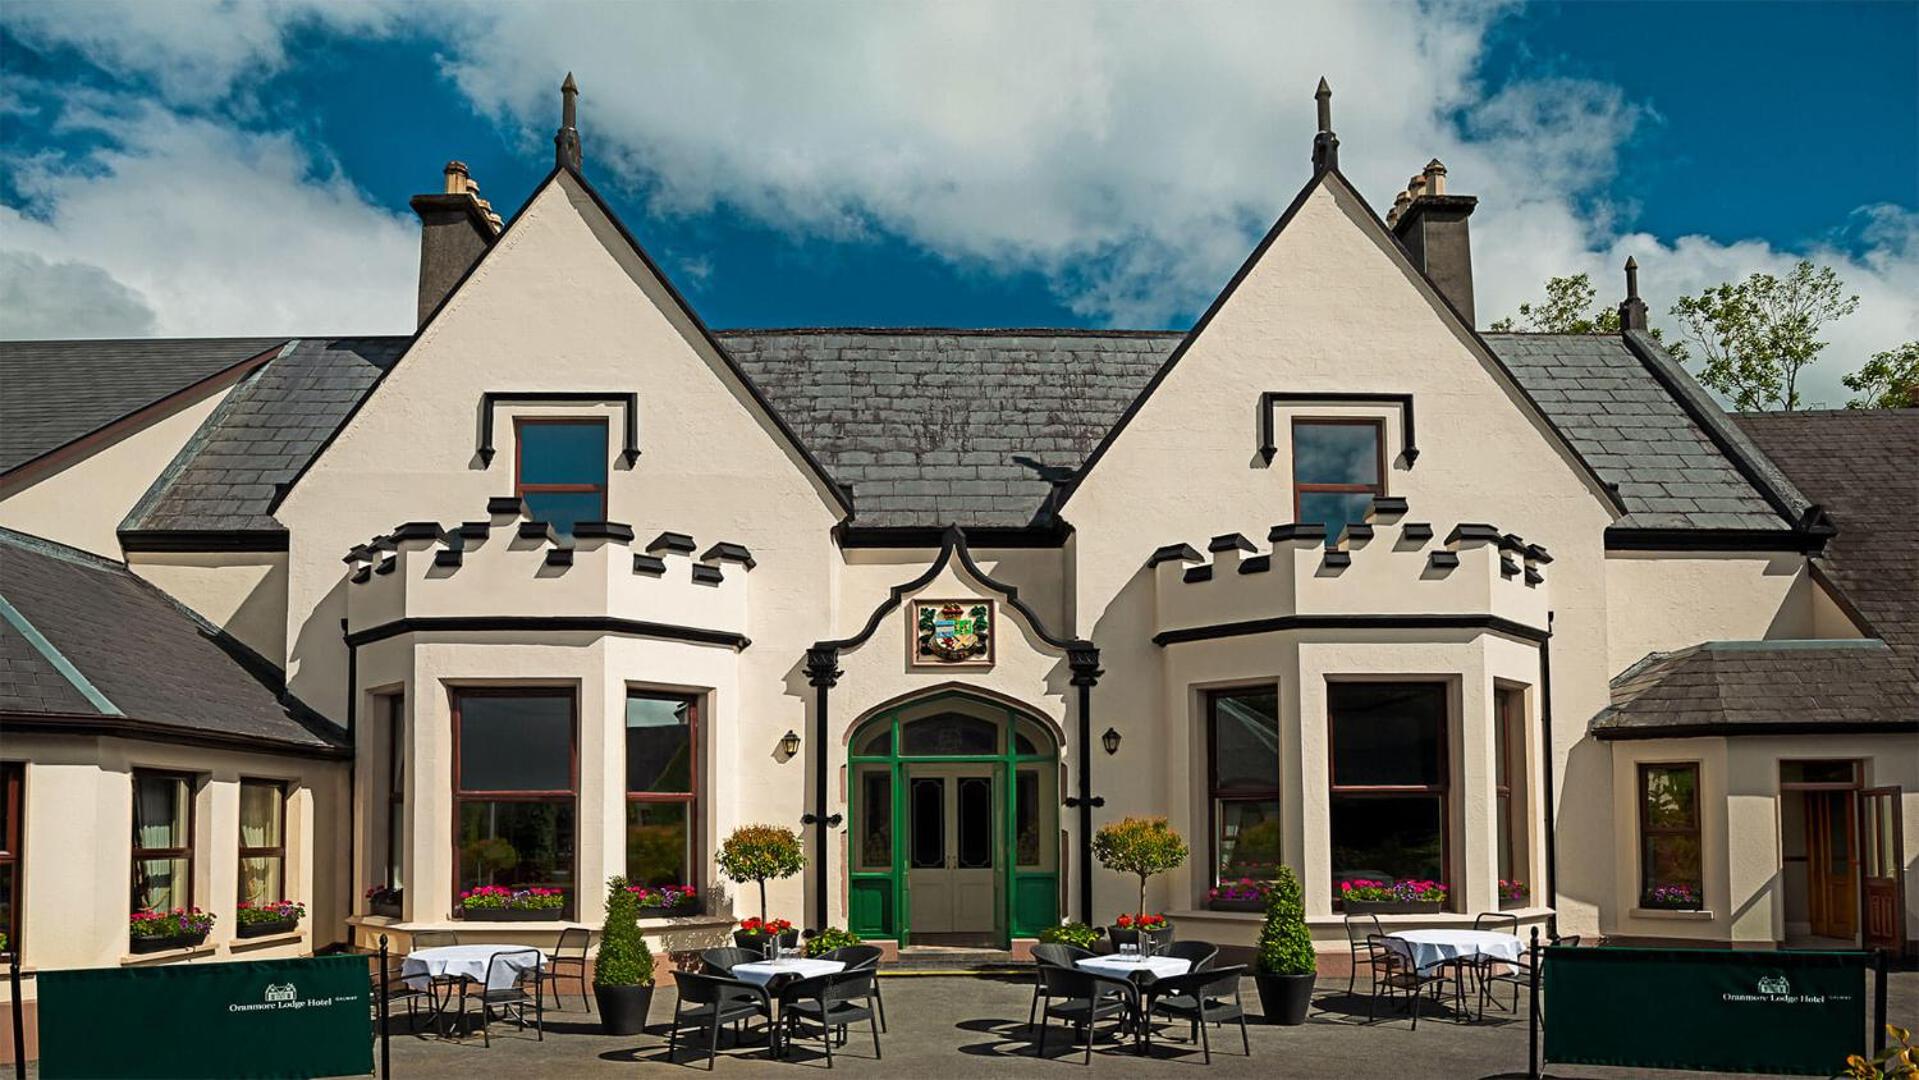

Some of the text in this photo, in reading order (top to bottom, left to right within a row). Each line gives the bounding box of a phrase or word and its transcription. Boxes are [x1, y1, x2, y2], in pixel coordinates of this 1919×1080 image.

[1722, 993, 1768, 1001] Oranmore
[1770, 994, 1798, 1004] Lodge
[1800, 995, 1825, 1003] Hotel
[229, 1003, 276, 1012] Oranmore
[278, 1000, 305, 1009] Lodge
[307, 998, 332, 1006] Hotel
